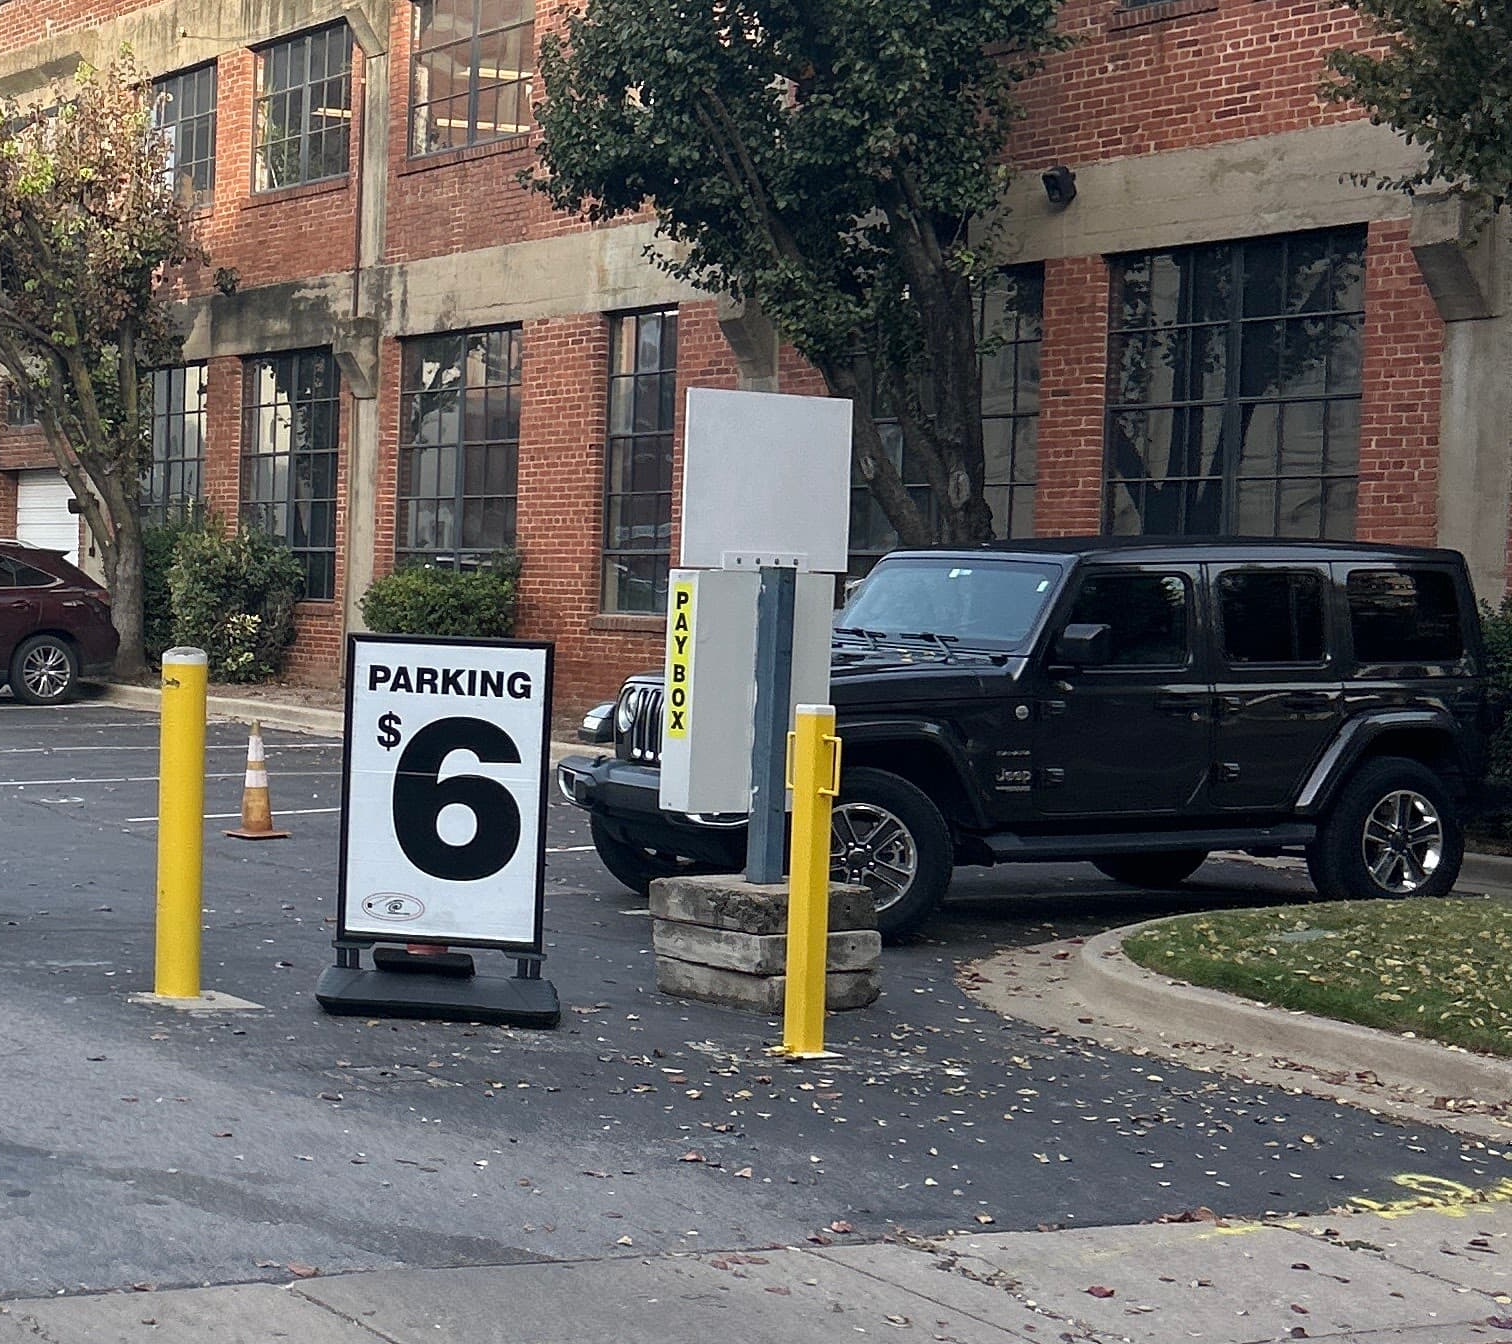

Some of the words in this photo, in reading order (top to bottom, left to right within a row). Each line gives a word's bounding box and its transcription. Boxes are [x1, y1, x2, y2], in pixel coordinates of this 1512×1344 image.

[674, 591, 689, 655] PAY
[368, 664, 532, 699] PARKING
[670, 663, 686, 730] BOX
[377, 711, 522, 881] $6
